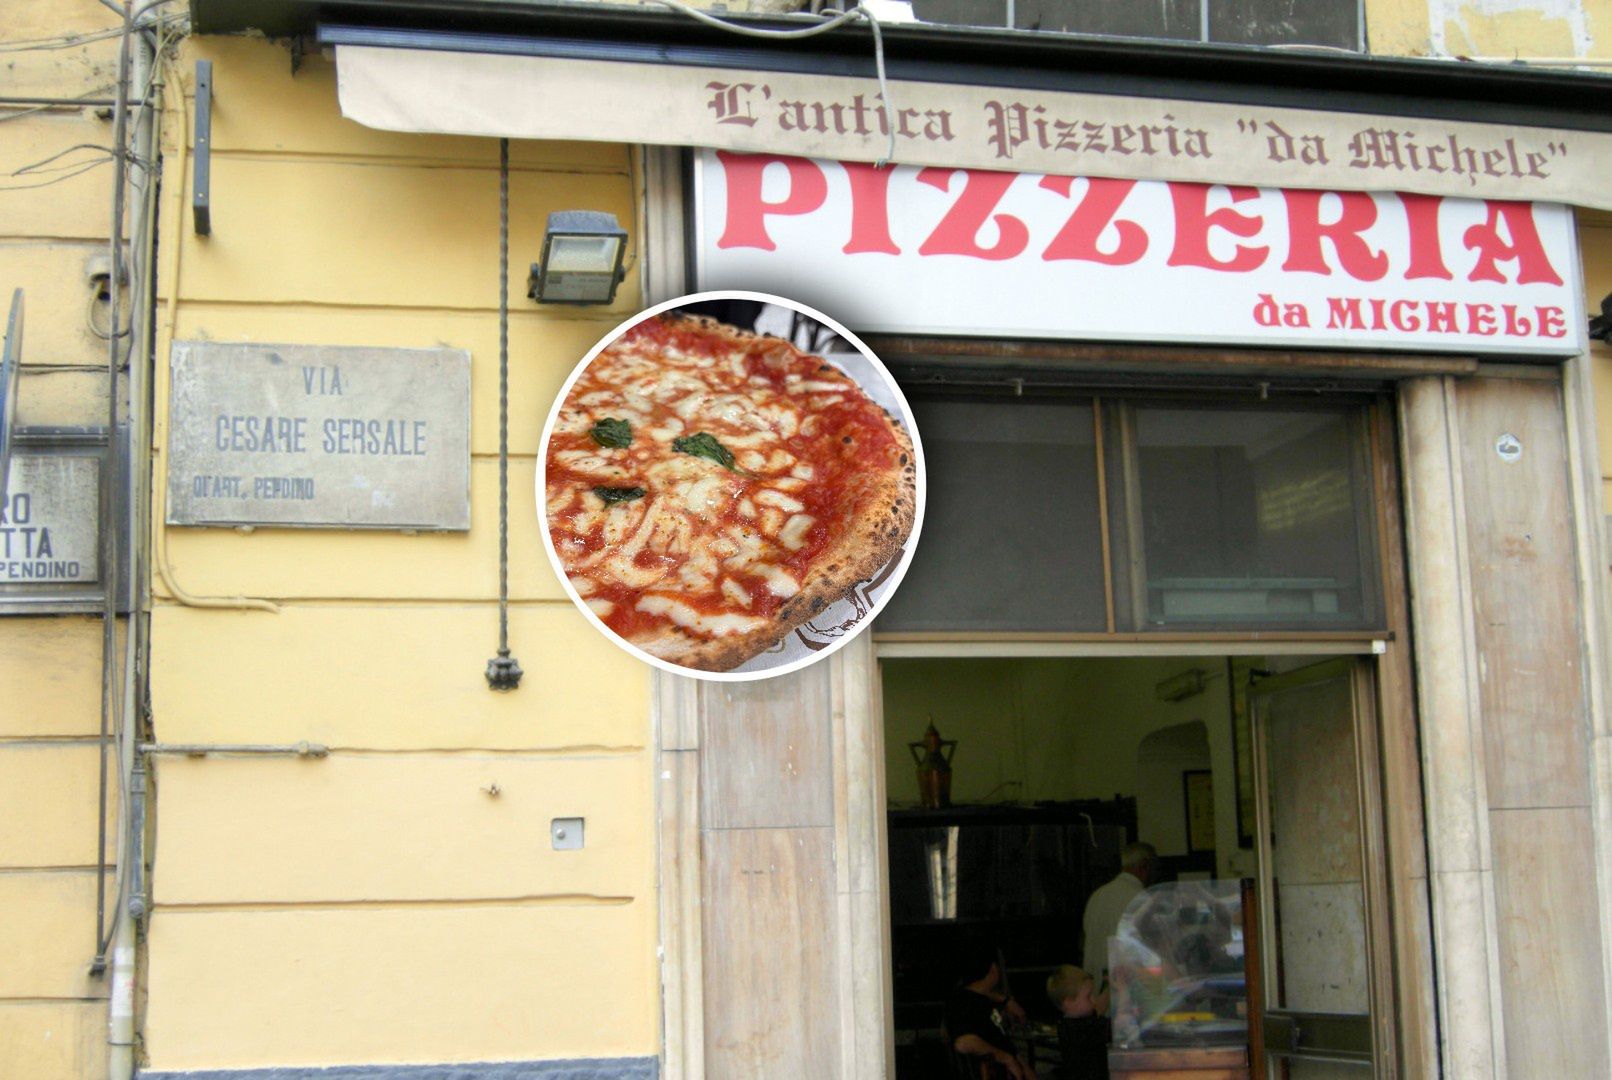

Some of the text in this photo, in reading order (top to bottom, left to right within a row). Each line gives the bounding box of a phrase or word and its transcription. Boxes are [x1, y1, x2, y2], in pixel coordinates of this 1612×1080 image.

[705, 81, 956, 142] L'antica
[984, 99, 1212, 160] Pizzeria
[1348, 127, 1567, 186] Michele"
[715, 148, 1563, 287] PIZZERIA
[1253, 293, 1568, 339] da MICHELE
[302, 365, 342, 396] VIA
[215, 414, 426, 456] CESARE SERSALE
